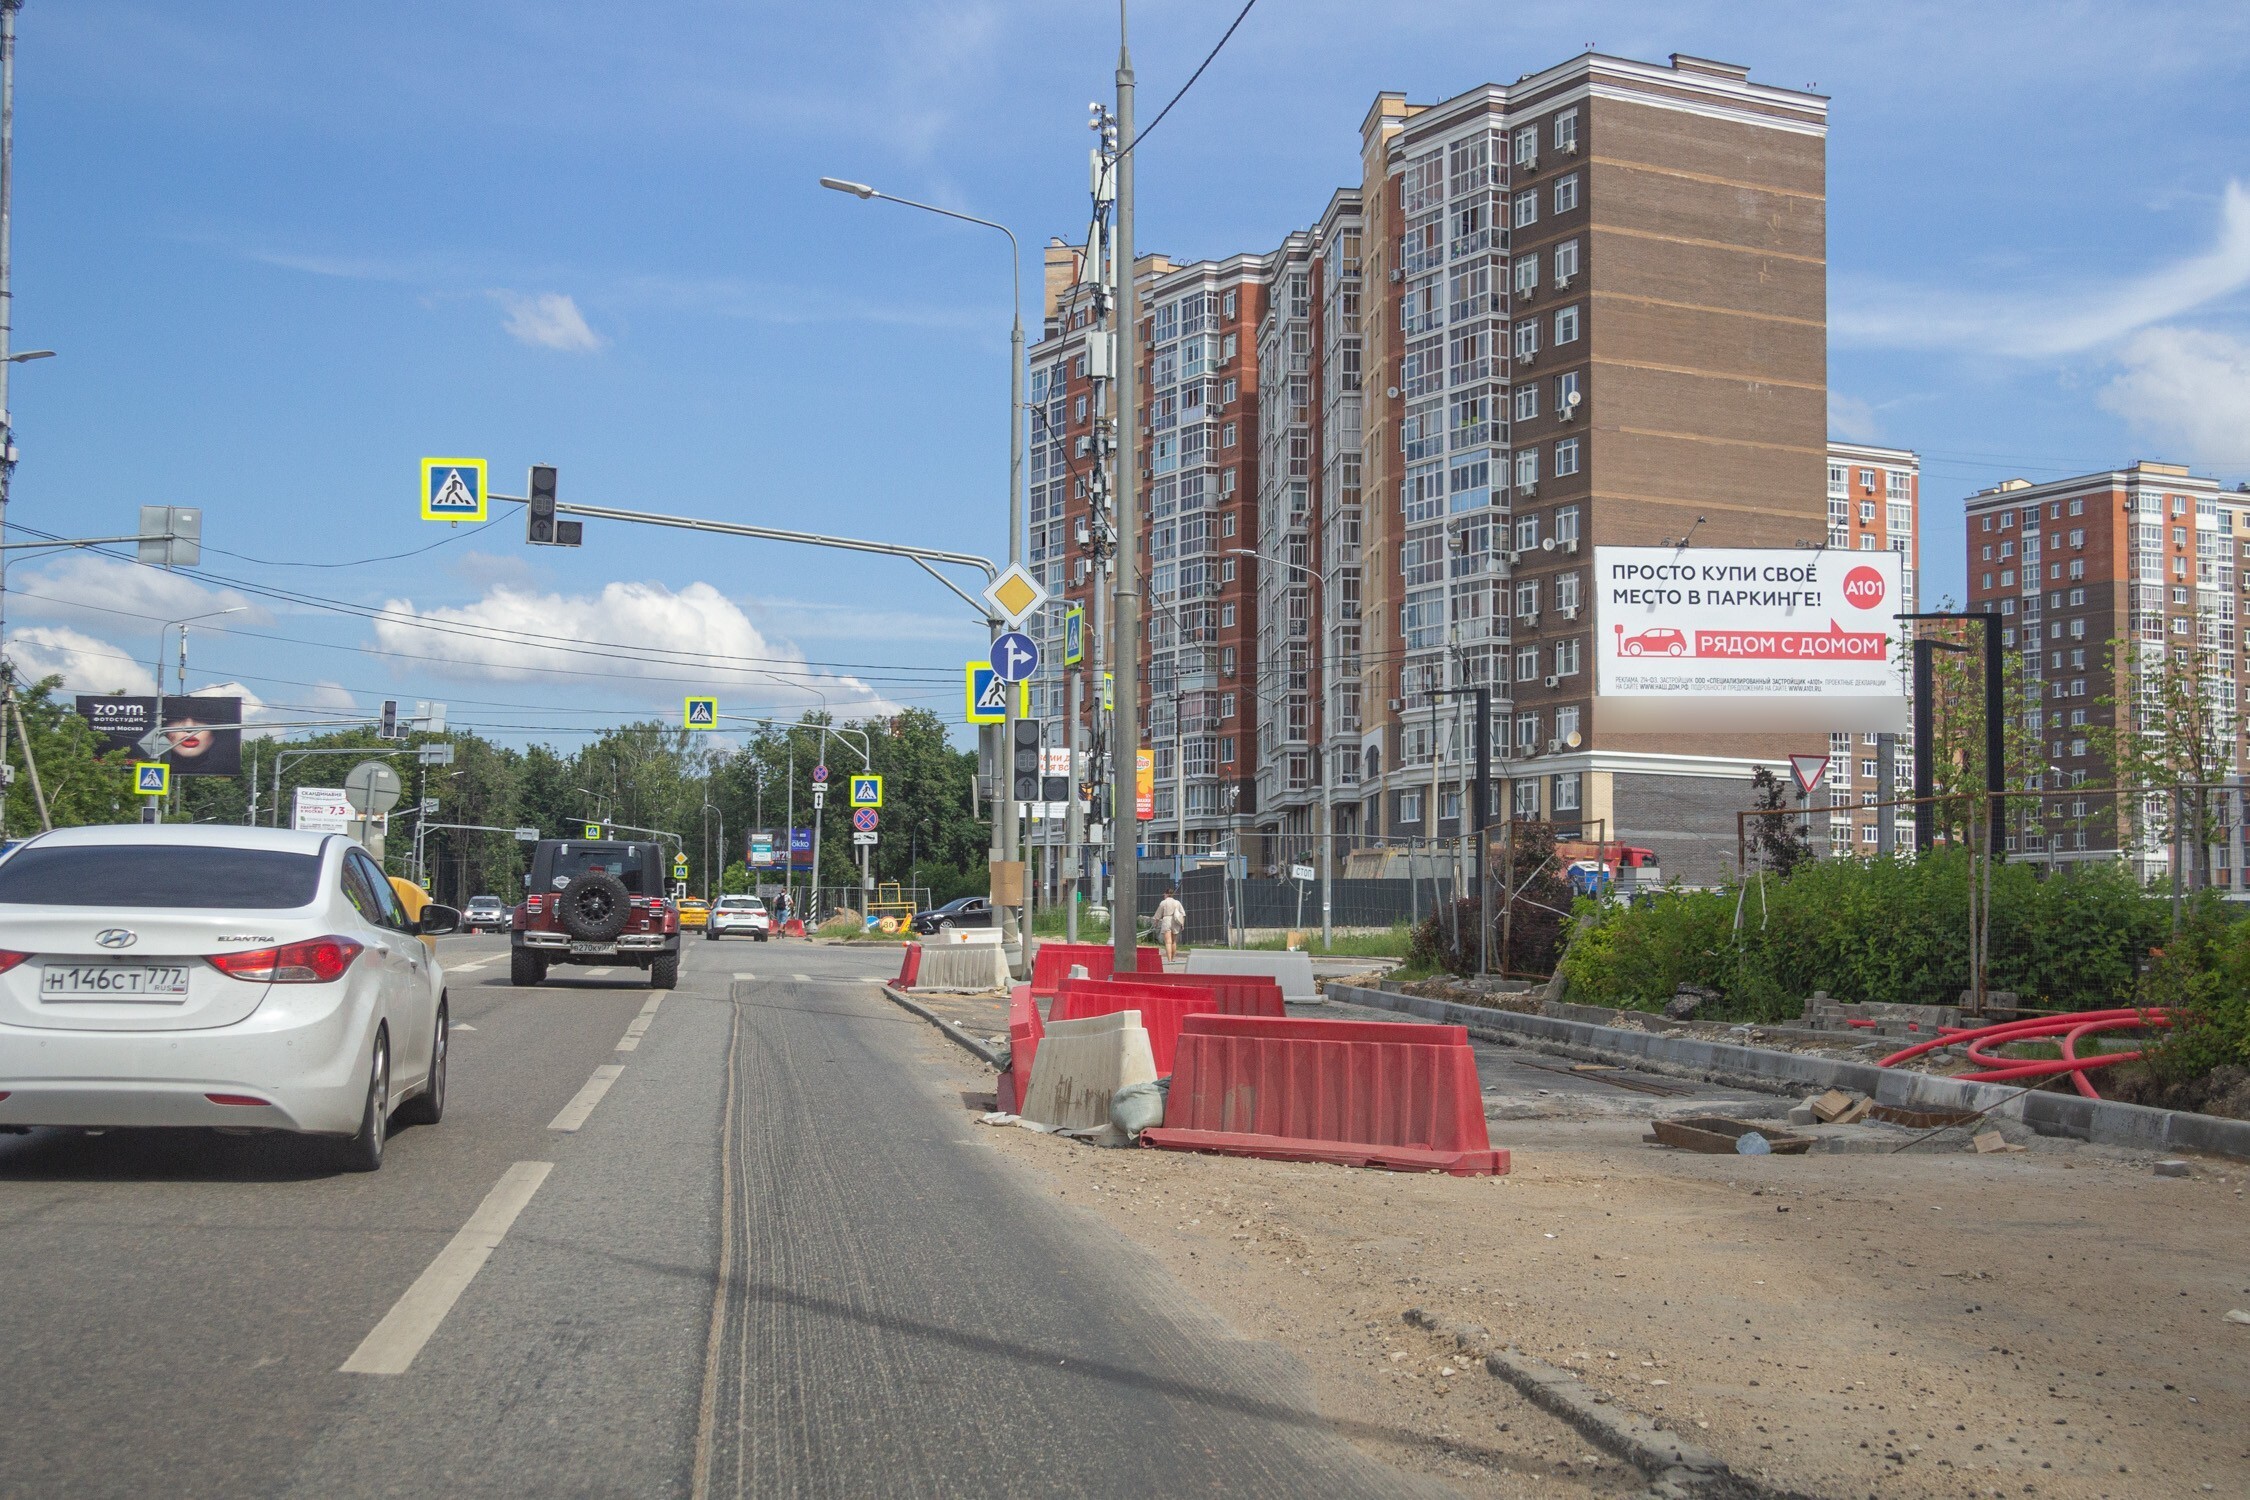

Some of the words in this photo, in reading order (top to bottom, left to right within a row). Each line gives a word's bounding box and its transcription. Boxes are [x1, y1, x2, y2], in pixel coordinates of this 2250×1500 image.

[1612, 564, 1697, 581] ПРОСТО
[1702, 565, 1757, 582] КУПИ
[1763, 562, 1818, 583] СВОЁ
[1845, 579, 1883, 597] А101
[1613, 588, 1682, 605] МЕСТО
[1688, 589, 1701, 605] В
[1706, 589, 1822, 607] ПАРКИНГЕ!
[1701, 635, 1776, 656] РЯДОМ
[1781, 637, 1795, 653] С
[1798, 637, 1879, 657] ДОМОМ
[1772, 677, 1806, 685] ЗАСТРОЙЩИК
[1295, 867, 1313, 878] СТОП
[217, 935, 276, 943] ELANTRA
[50, 968, 142, 990] Н146СТ
[147, 967, 181, 985] 777
